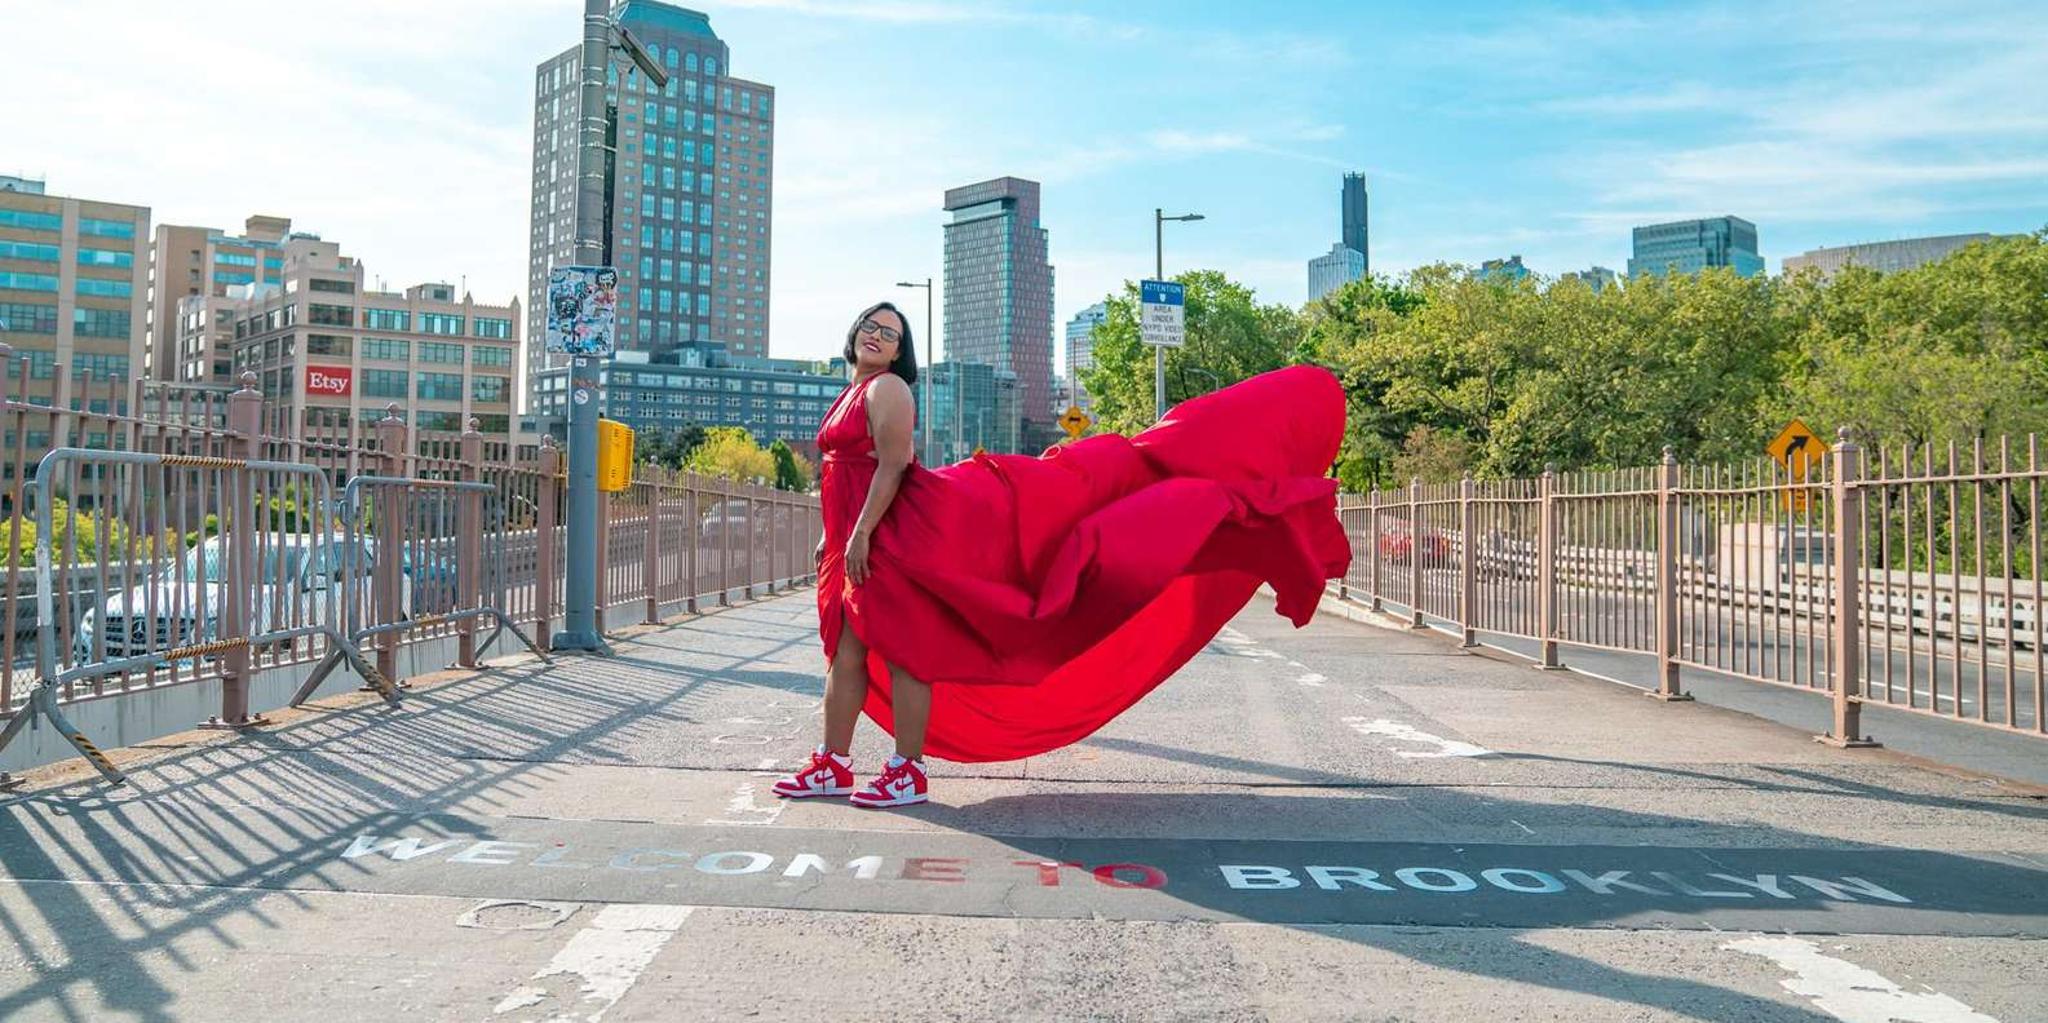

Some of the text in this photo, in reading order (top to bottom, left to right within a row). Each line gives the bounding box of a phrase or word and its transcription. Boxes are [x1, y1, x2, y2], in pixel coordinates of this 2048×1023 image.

[1144, 283, 1182, 294] ATTENTION
[1153, 305, 1172, 313] AREA
[1151, 314, 1174, 322] UNDER
[309, 372, 348, 393] Etsy
[340, 835, 1913, 903] WELCOME TO BROOKLYN
